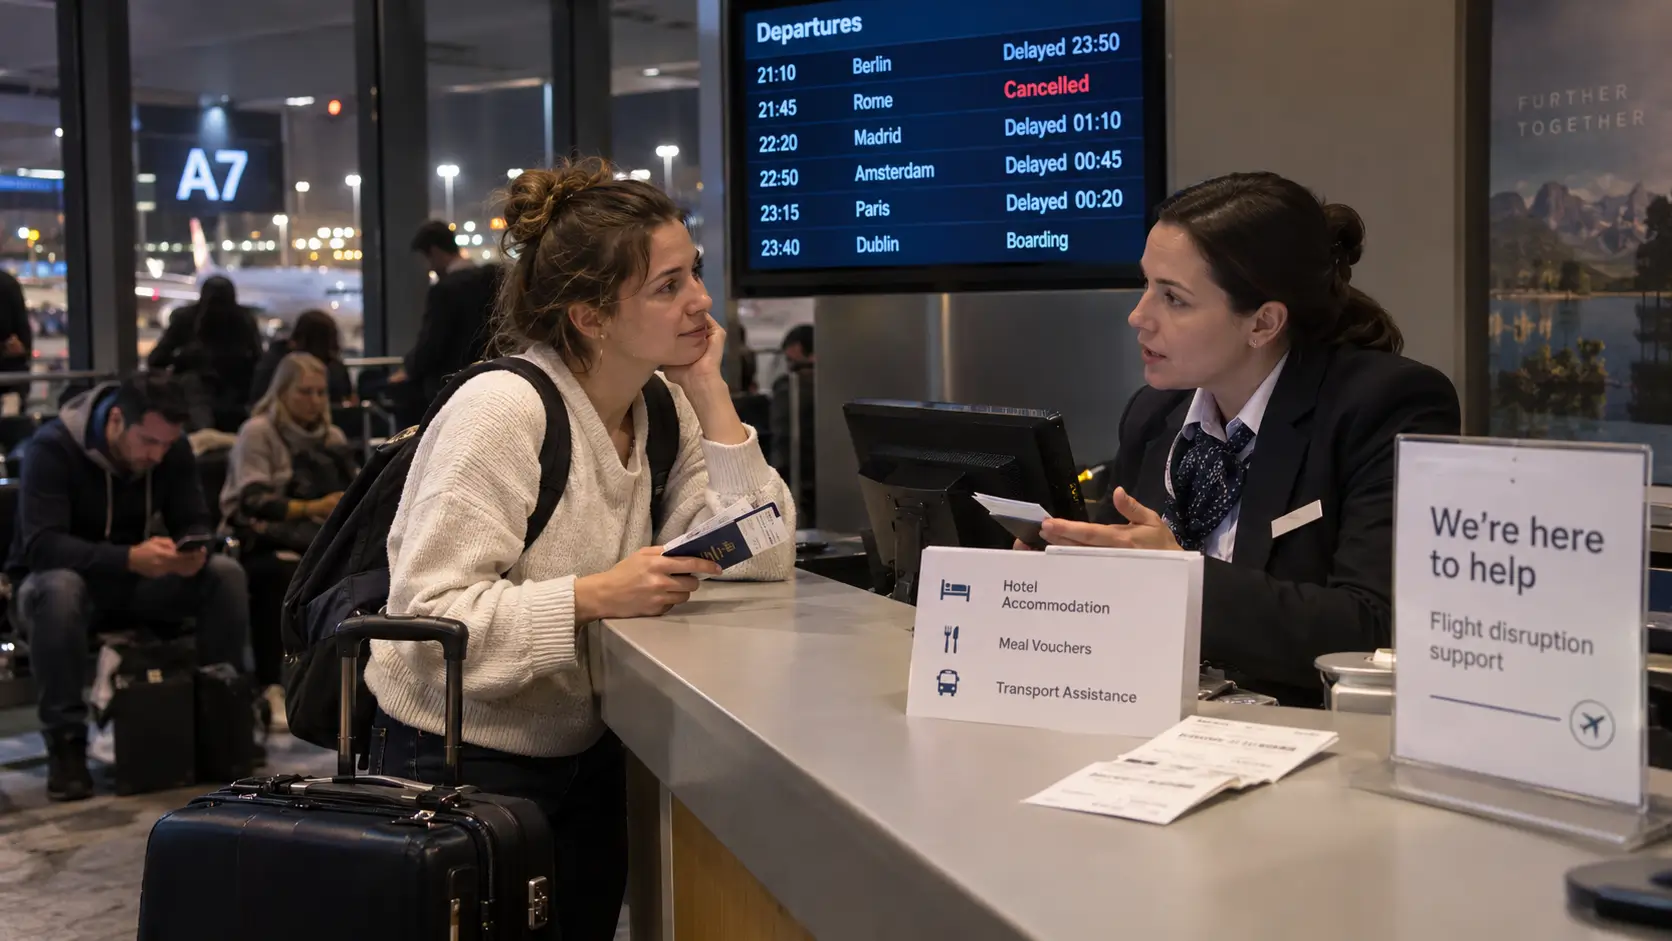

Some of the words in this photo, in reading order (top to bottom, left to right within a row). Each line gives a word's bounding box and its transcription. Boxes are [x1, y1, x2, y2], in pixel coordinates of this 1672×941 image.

[757, 15, 863, 45] Departures
[757, 64, 797, 84] 21:10
[852, 56, 892, 75] Berlin
[1003, 38, 1066, 61] Delayed
[1071, 32, 1121, 55] 23:50
[758, 99, 798, 119] 21:45
[853, 93, 894, 111] Rome
[1004, 74, 1090, 99] Cancelled
[1518, 84, 1628, 112] FURTHER
[758, 134, 799, 154] 22:20
[853, 127, 902, 146] Madrid
[1004, 115, 1067, 138] Delayed
[1073, 111, 1122, 132] 01:10
[1517, 109, 1645, 136] TOGETHER
[175, 147, 248, 201] A7
[759, 169, 799, 188] 22:50
[854, 162, 935, 182] Amsterdam
[1005, 153, 1068, 176] Delayed
[1074, 150, 1122, 171] 00:45
[760, 203, 800, 222] 23:15
[855, 200, 891, 218] Paris
[1006, 191, 1068, 214] Delayed
[1075, 188, 1123, 209] 00:20
[761, 238, 800, 257] 23:40
[856, 235, 900, 254] Dublin
[1006, 230, 1069, 251] Boarding
[1430, 506, 1520, 545] We’re
[1531, 515, 1605, 553] here
[1003, 579, 1038, 593] Hotel
[1430, 550, 1460, 579] to
[1470, 551, 1537, 596] help
[1001, 596, 1110, 615] Accommodation
[999, 637, 1029, 651] Meal
[1032, 639, 1092, 655] Vouchers
[1430, 611, 1484, 641] Flight
[1489, 620, 1594, 656] disruption
[1430, 644, 1504, 671] support
[996, 681, 1060, 699] Transport
[1063, 685, 1137, 704] Assistance
